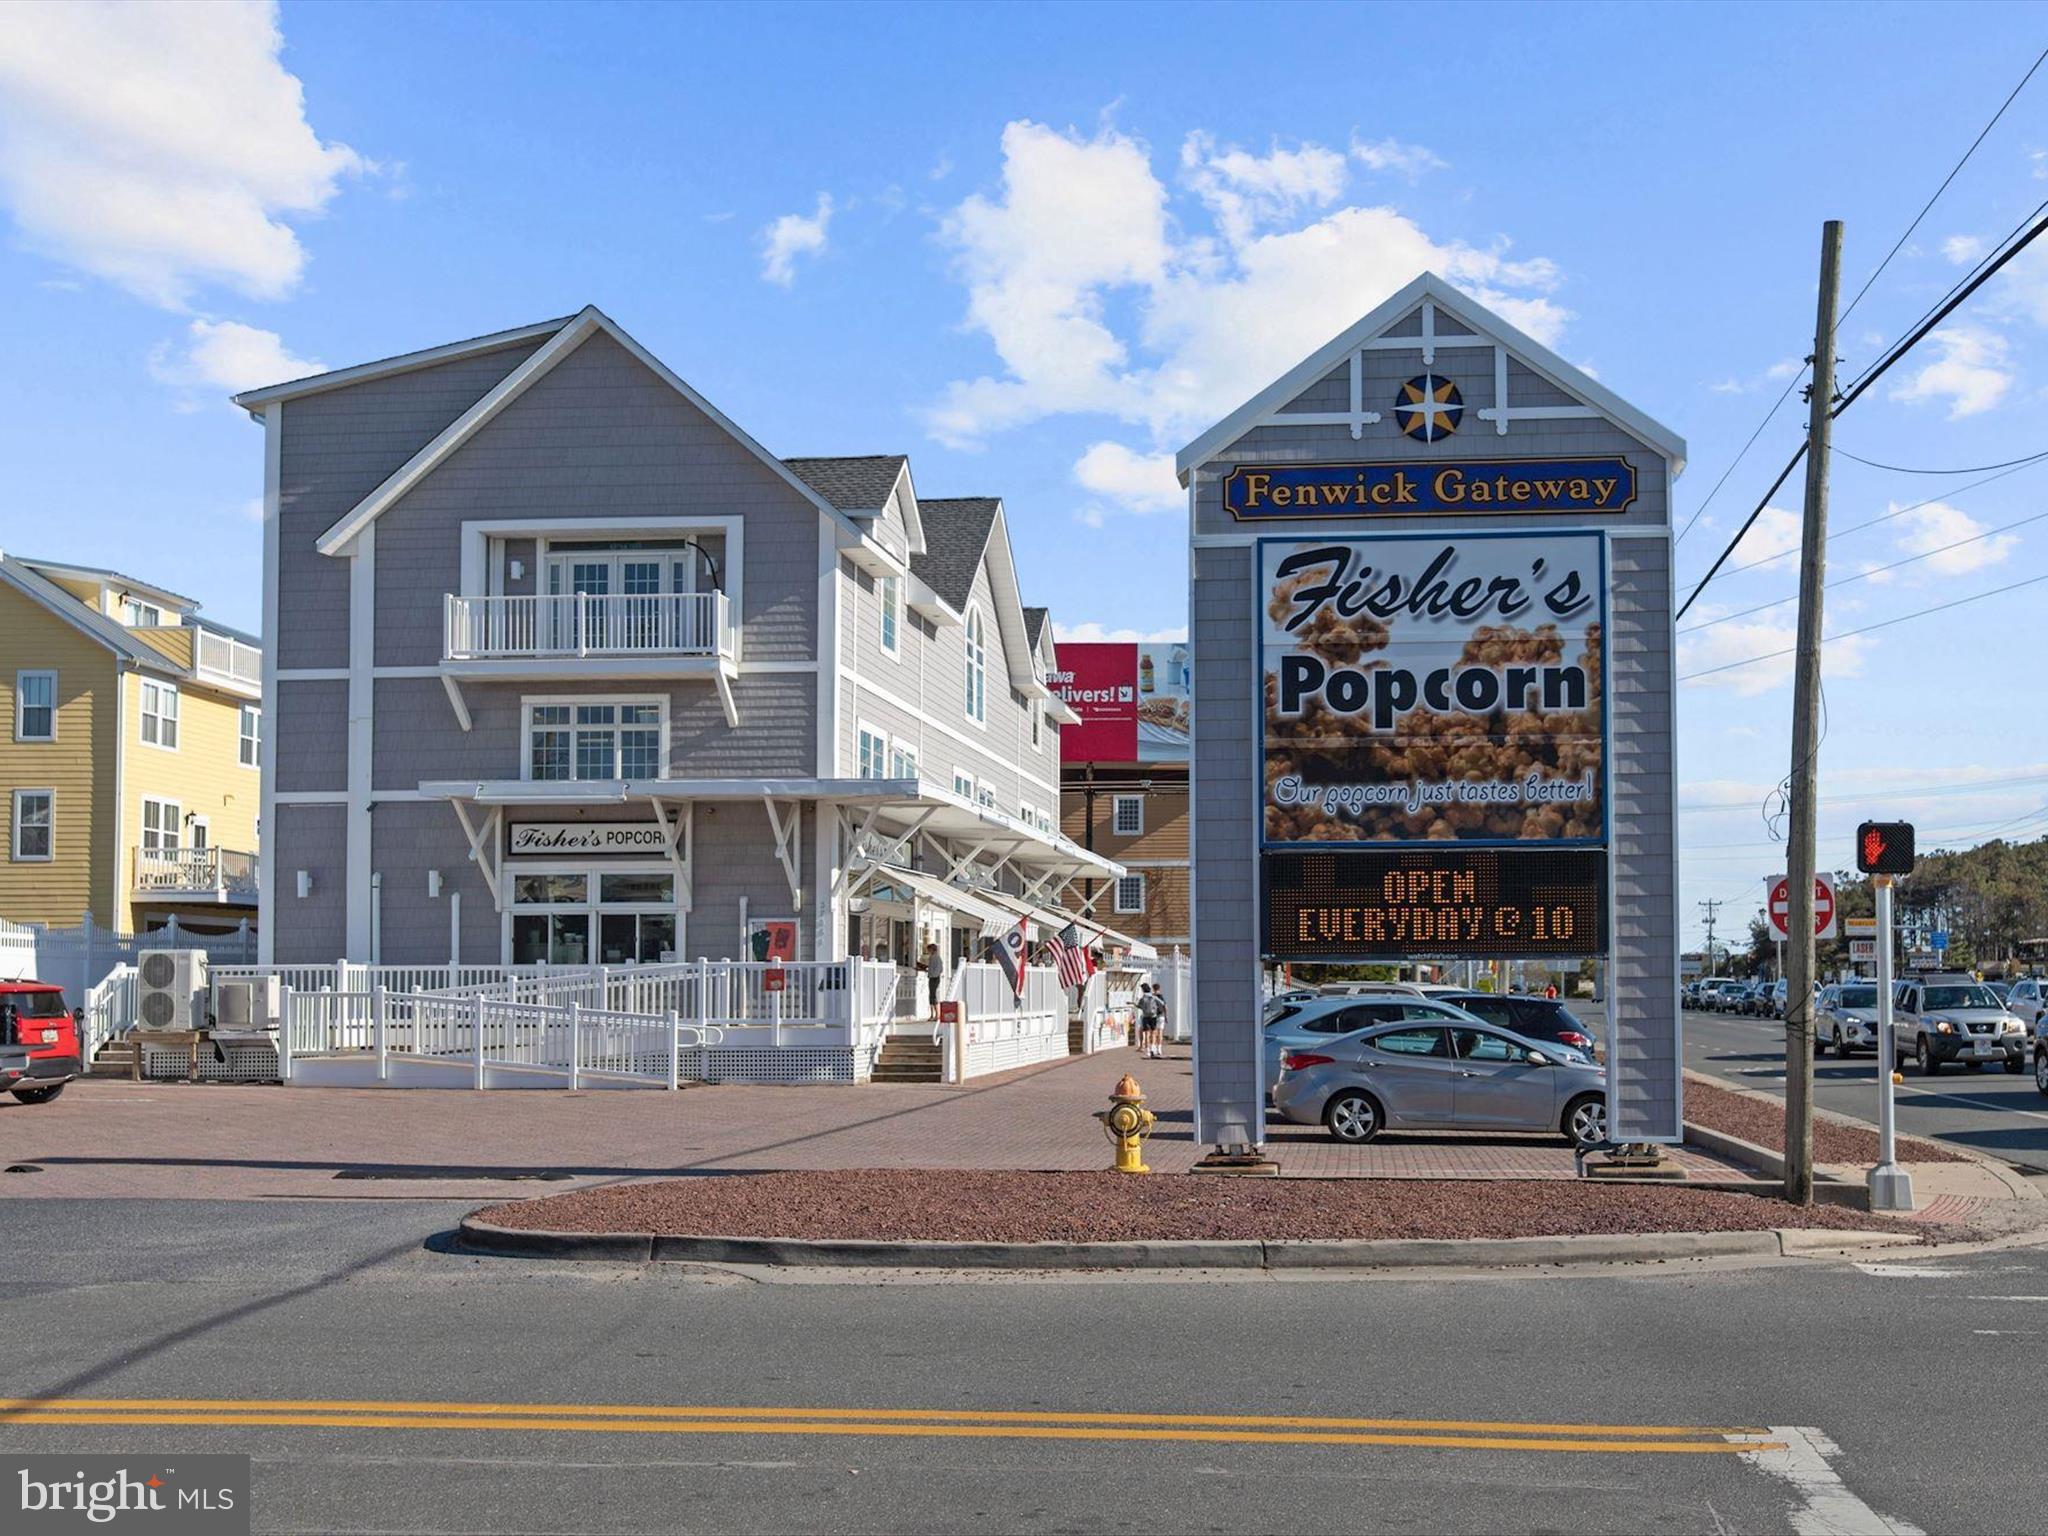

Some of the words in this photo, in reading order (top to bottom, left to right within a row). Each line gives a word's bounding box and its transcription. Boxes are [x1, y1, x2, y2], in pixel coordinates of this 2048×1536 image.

[1245, 472, 1418, 507] Fenwick
[1433, 469, 1617, 504] Gateway
[1275, 545, 1591, 632] Fisher's
[1046, 671, 1075, 683] awa
[1052, 686, 1115, 702] elivers!
[1281, 655, 1585, 729] Popcorn
[1275, 776, 1320, 803] Our
[1323, 785, 1409, 815] popcorn
[1408, 780, 1453, 813] just
[1459, 782, 1519, 801] tastes
[1525, 770, 1593, 801] better!
[515, 828, 602, 848] Fisher's
[606, 830, 666, 844] POPCOR
[1384, 871, 1475, 904] OPEN
[1300, 907, 1483, 941] EVERYDAY
[1531, 906, 1574, 940] 10
[1853, 943, 1874, 954] LASER
